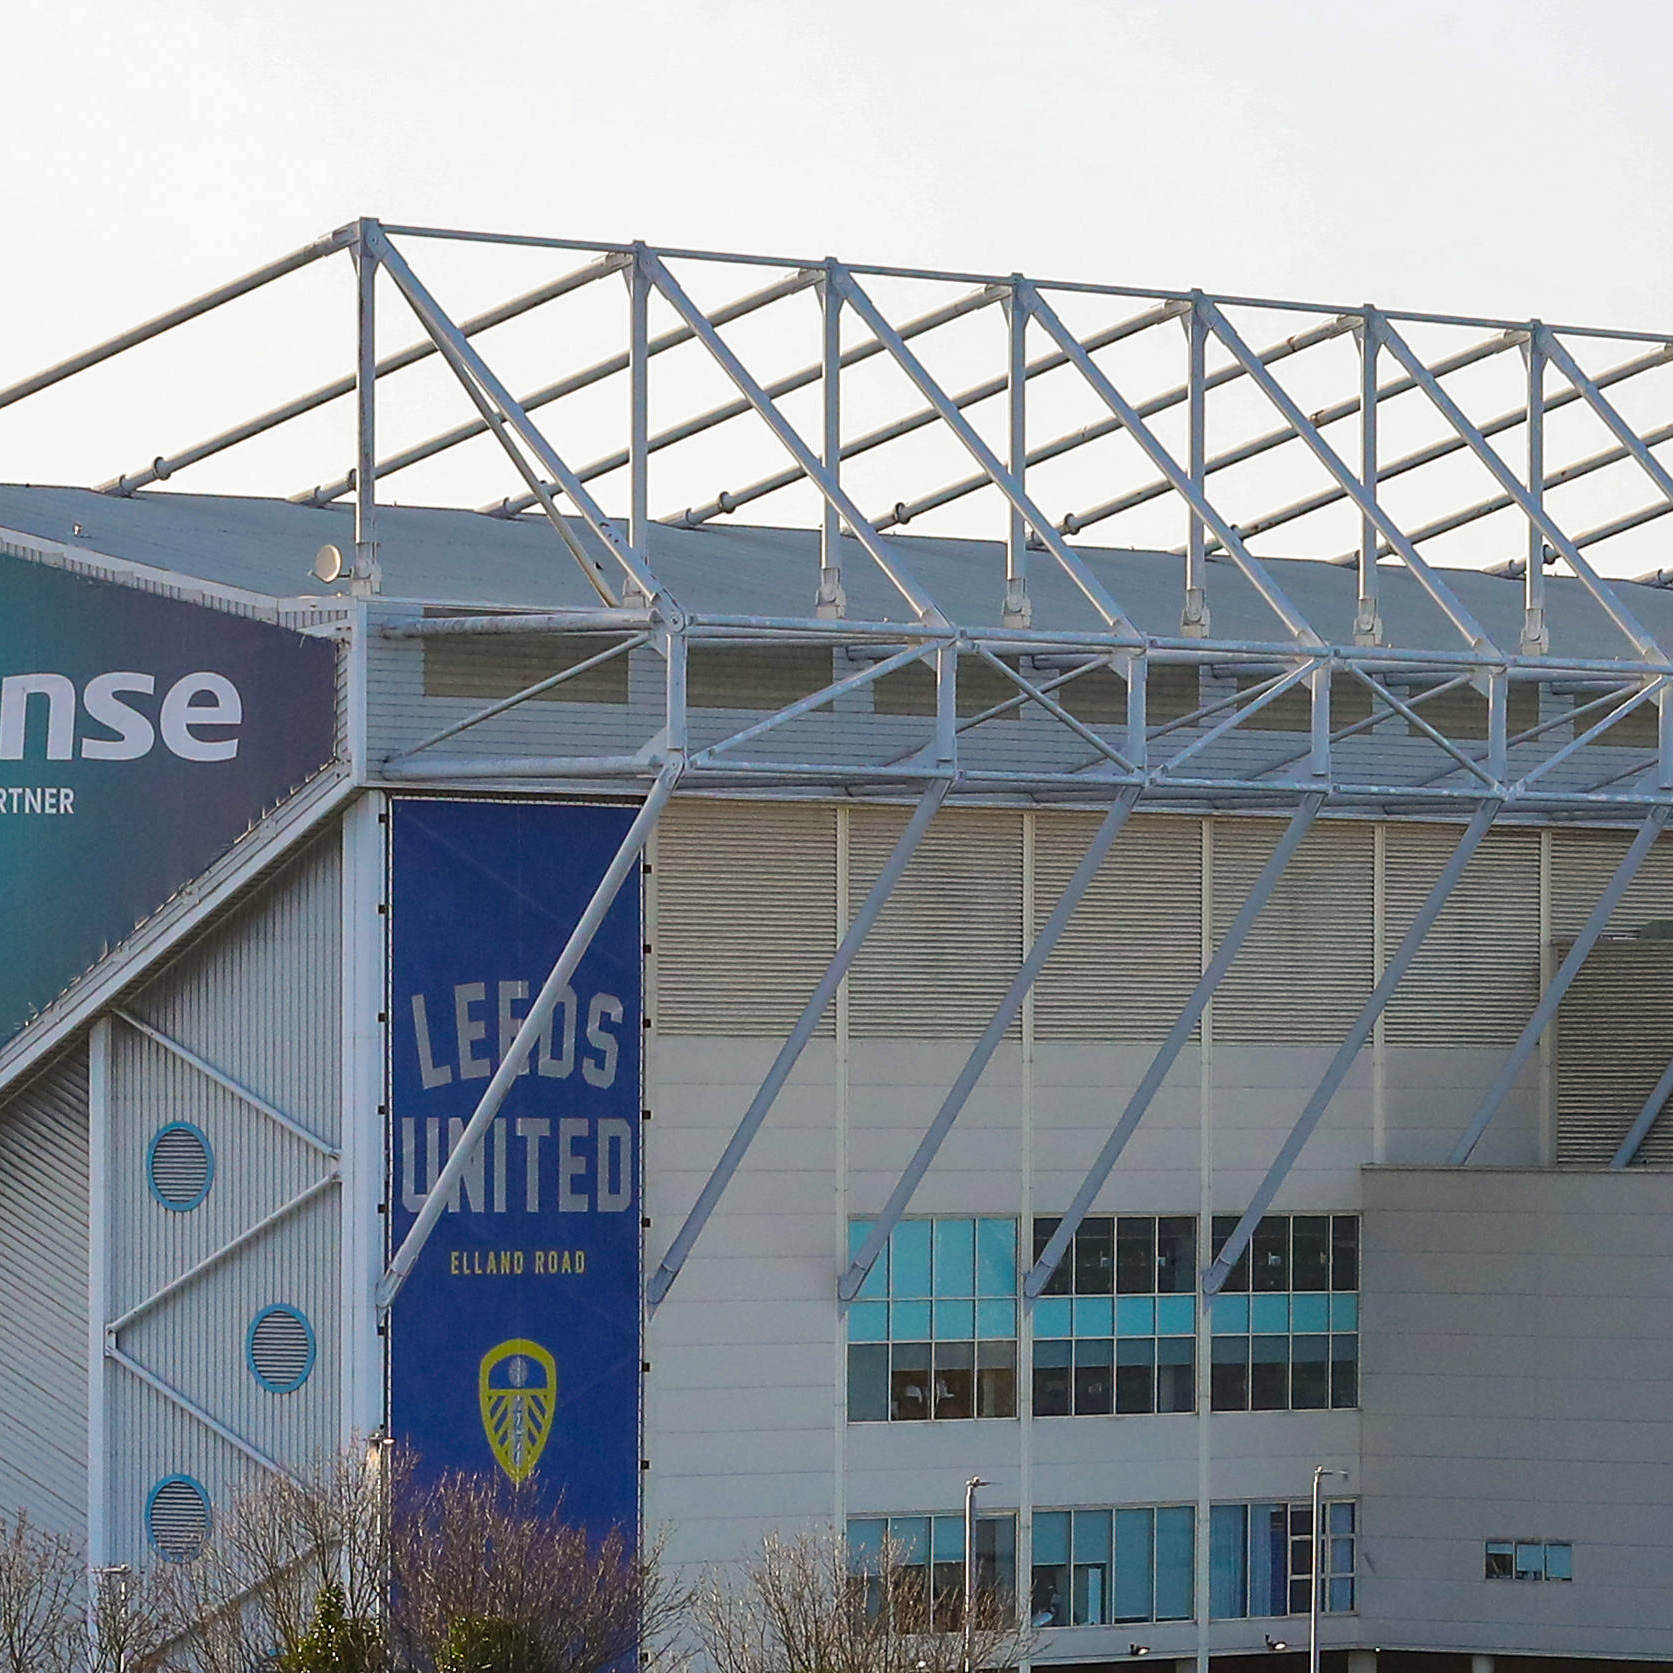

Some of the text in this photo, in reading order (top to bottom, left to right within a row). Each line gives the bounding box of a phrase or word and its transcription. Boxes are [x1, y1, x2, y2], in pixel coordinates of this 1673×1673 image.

[411, 980, 623, 1090] LEEDS
[402, 1117, 632, 1213] UNITED
[451, 1251, 586, 1274] ELLAND ROAD
